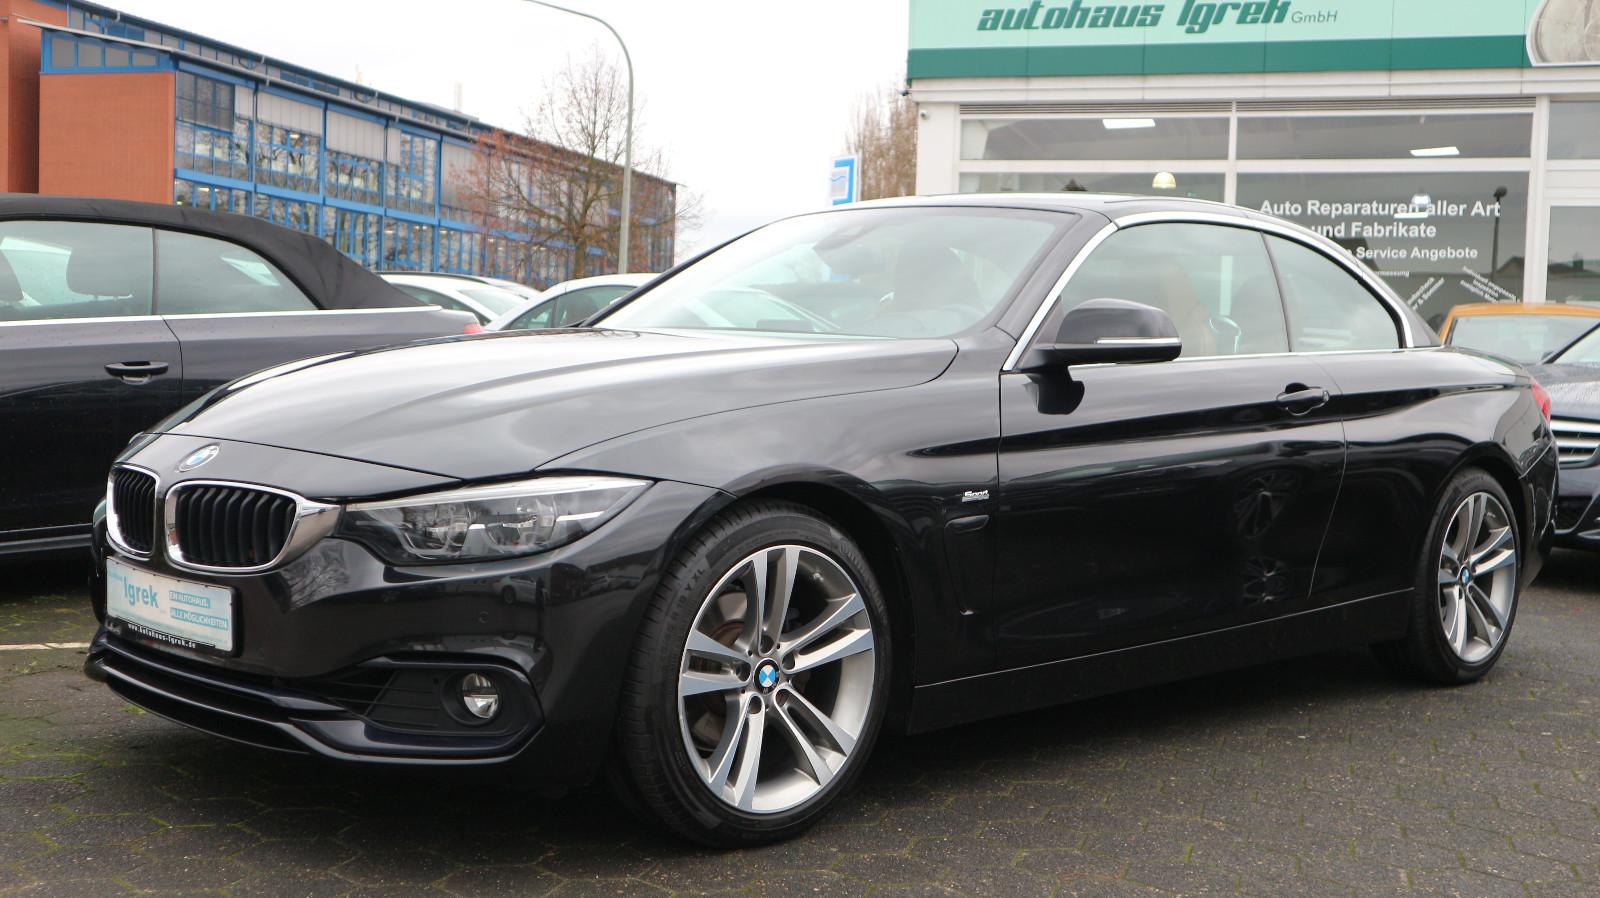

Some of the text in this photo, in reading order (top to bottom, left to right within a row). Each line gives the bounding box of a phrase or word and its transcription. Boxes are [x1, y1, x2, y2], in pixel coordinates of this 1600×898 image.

[976, 0, 1338, 34] autohaus Igrek GmbH
[1260, 200, 1501, 218] Auto Reparaturen aller Art
[1350, 222, 1437, 238] Fabrikate
[1356, 246, 1407, 259] Service
[1410, 246, 1478, 261] Angebote
[123, 576, 159, 609] Igrek
